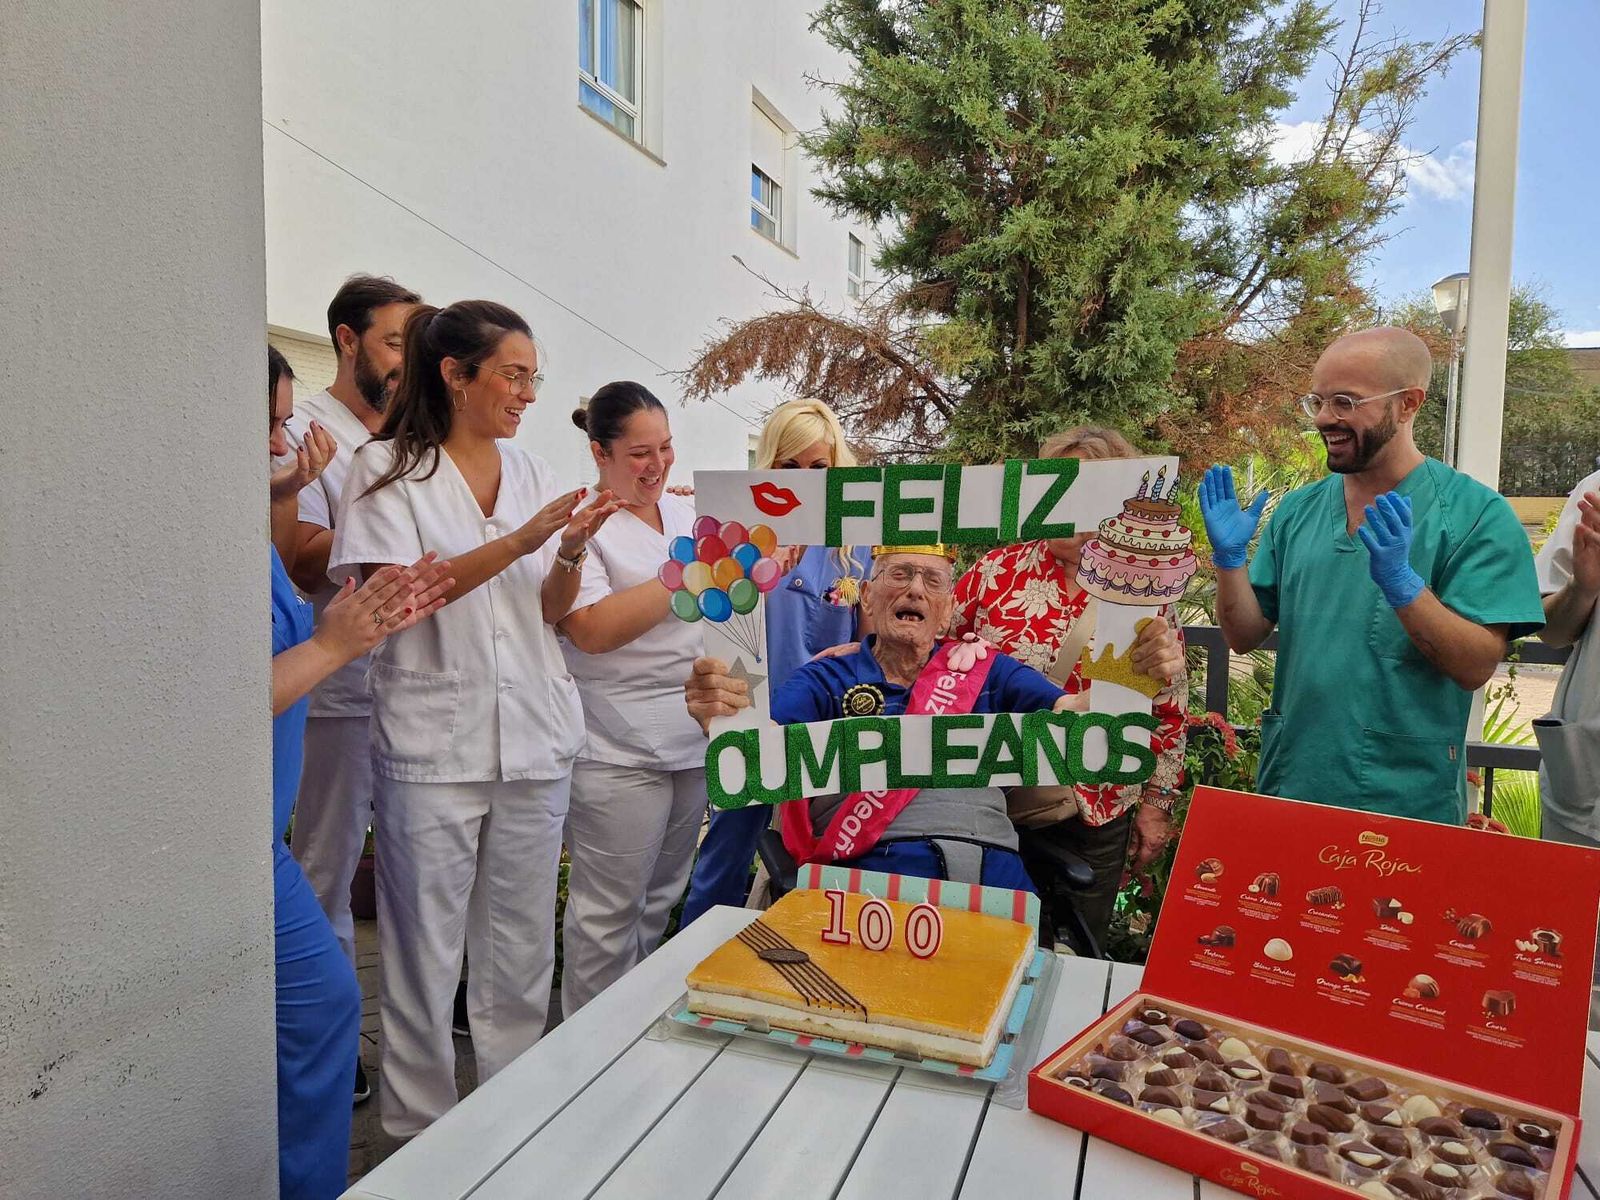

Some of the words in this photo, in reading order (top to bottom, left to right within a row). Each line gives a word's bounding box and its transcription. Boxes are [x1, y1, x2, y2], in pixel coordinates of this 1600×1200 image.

[825, 458, 1080, 547] FELIZ
[705, 707, 1162, 809] CUMPLEAÑOS
[1318, 845, 1357, 871] Caja
[1361, 849, 1422, 877] Roja
[821, 889, 943, 960] 100
